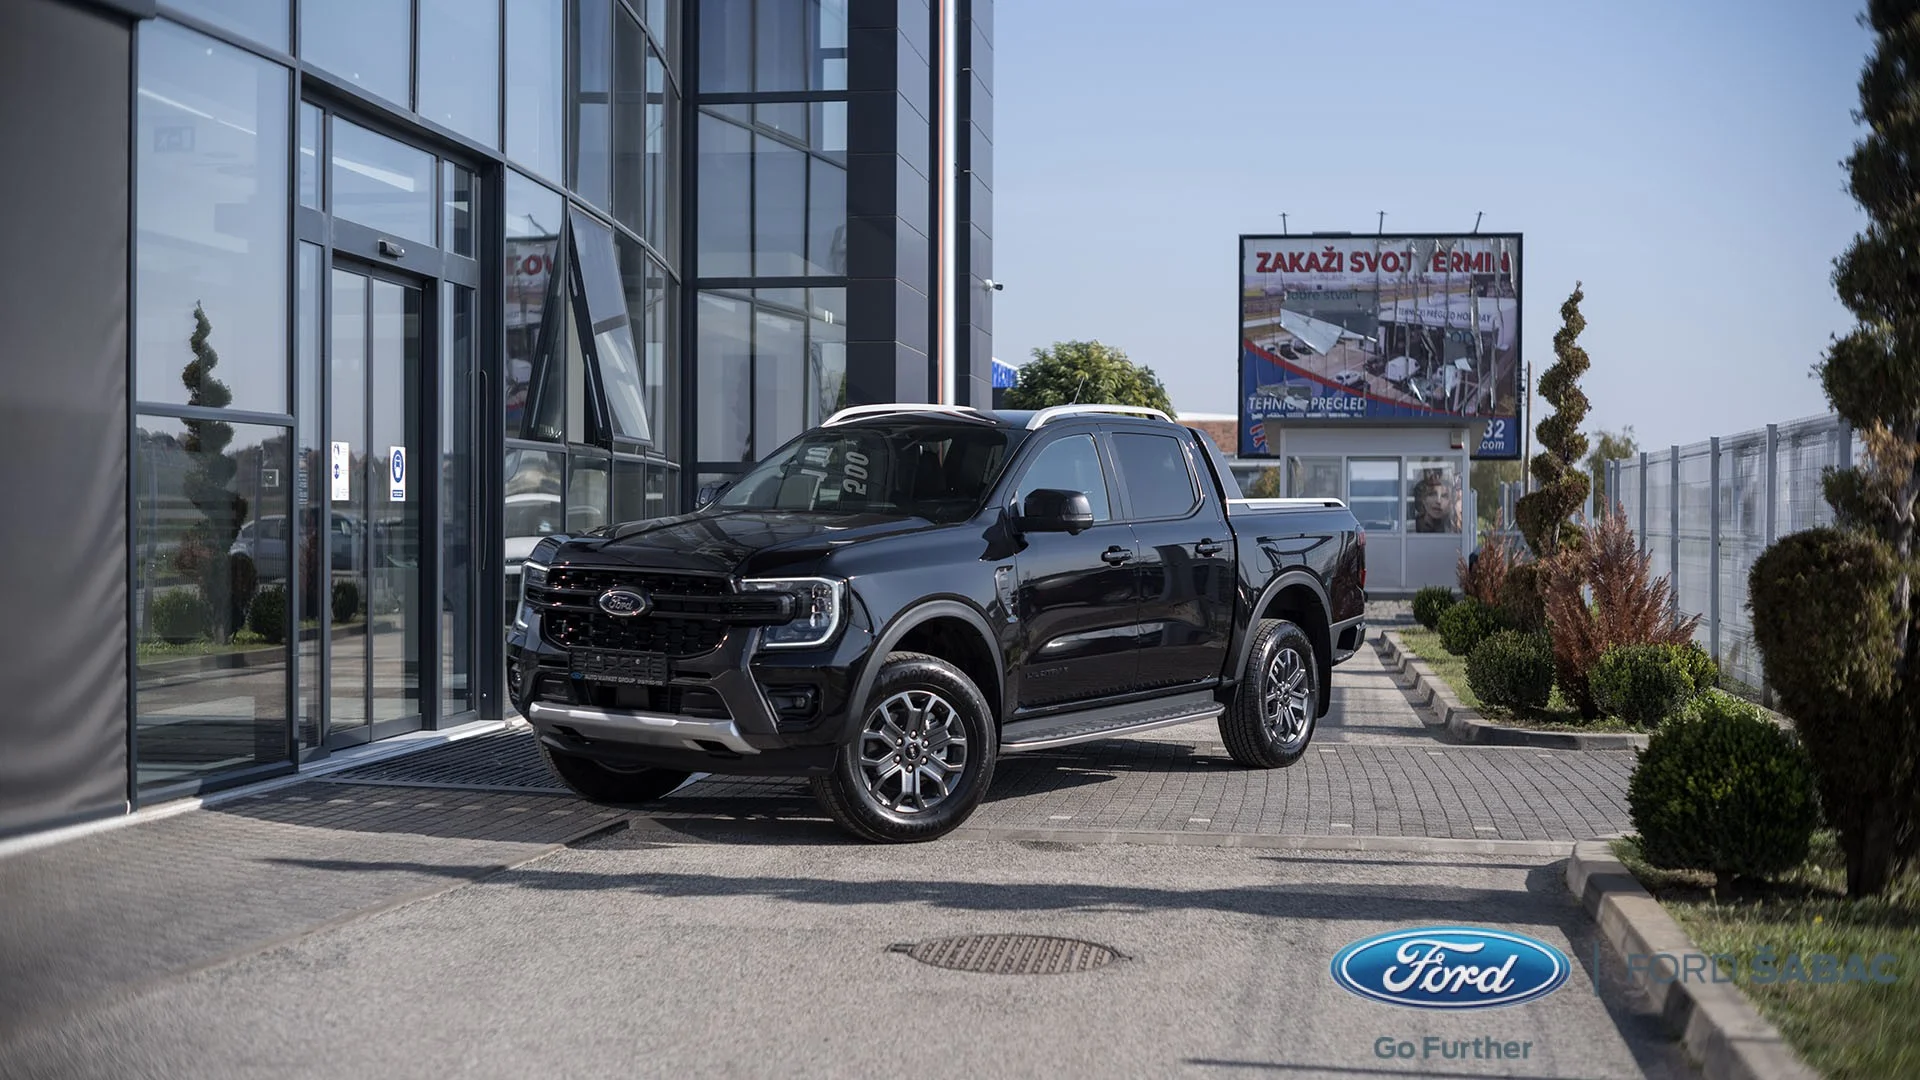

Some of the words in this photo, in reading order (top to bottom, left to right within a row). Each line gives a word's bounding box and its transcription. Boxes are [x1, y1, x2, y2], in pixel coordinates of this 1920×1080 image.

[1256, 246, 1343, 273] ZAKAŽI
[1350, 251, 1412, 273] SVOJ
[1424, 251, 1509, 273] ERMIN
[1311, 397, 1367, 410] PREGLED
[609, 595, 634, 610] Ford
